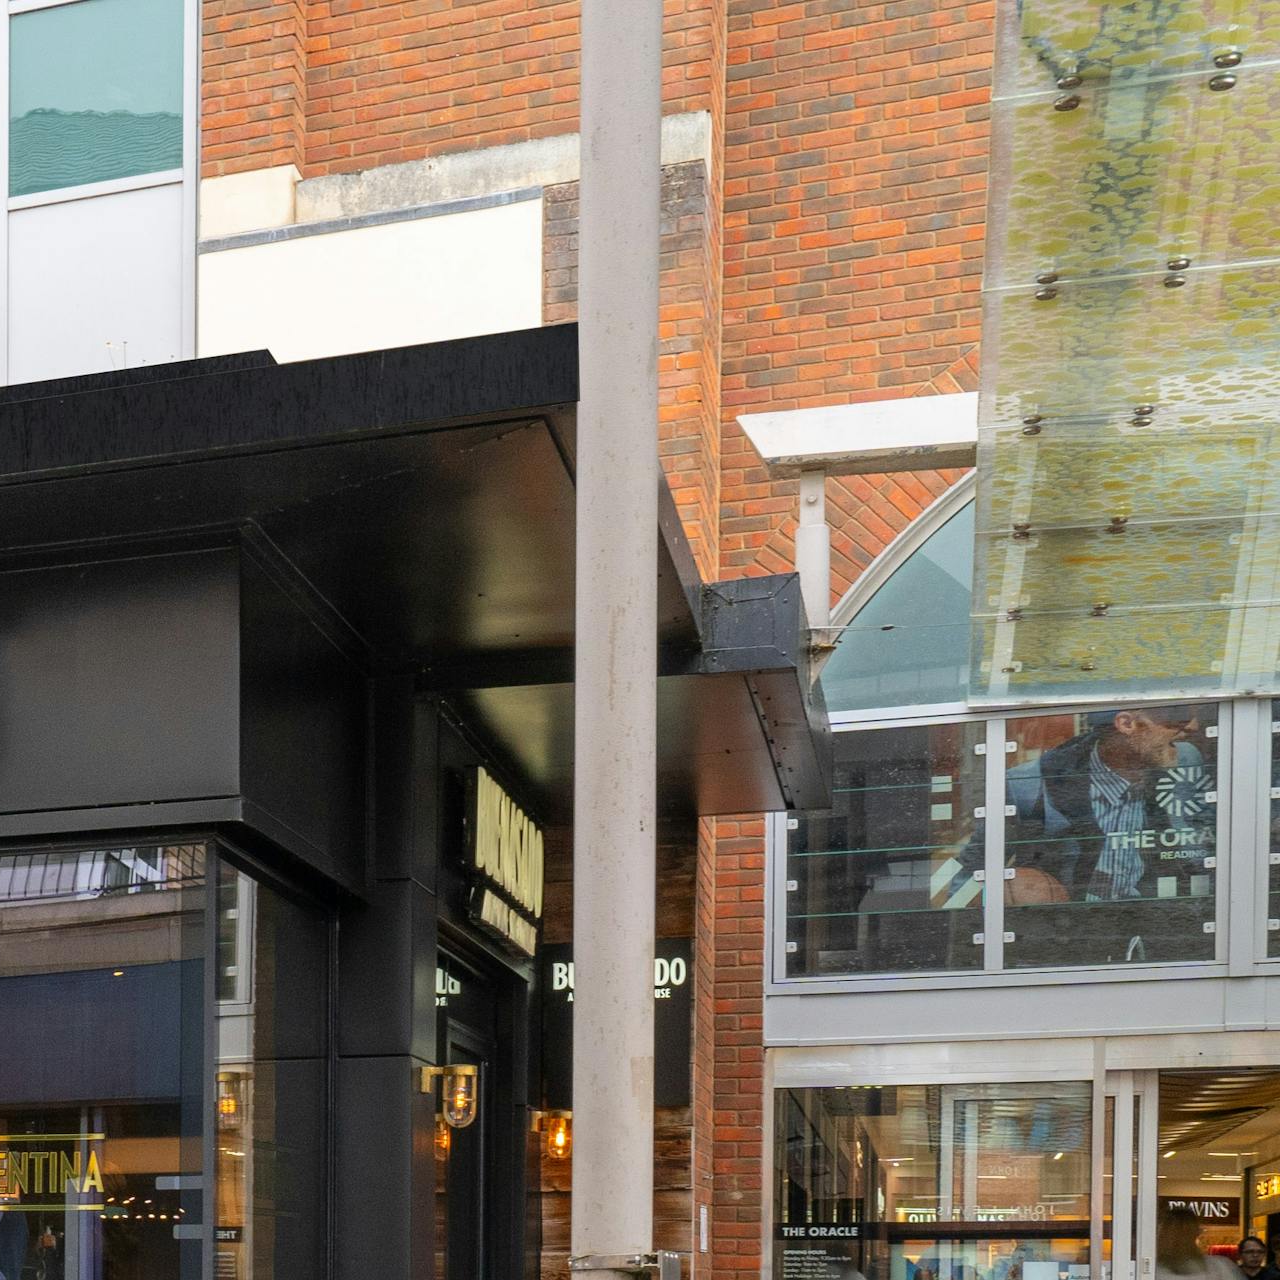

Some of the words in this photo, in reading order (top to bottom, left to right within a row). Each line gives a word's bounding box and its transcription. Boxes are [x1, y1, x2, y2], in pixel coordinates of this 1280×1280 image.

[1107, 829, 1156, 850] THE
[1159, 849, 1208, 860] READING
[782, 1227, 806, 1237] THE
[808, 1226, 859, 1237] ORACLE
